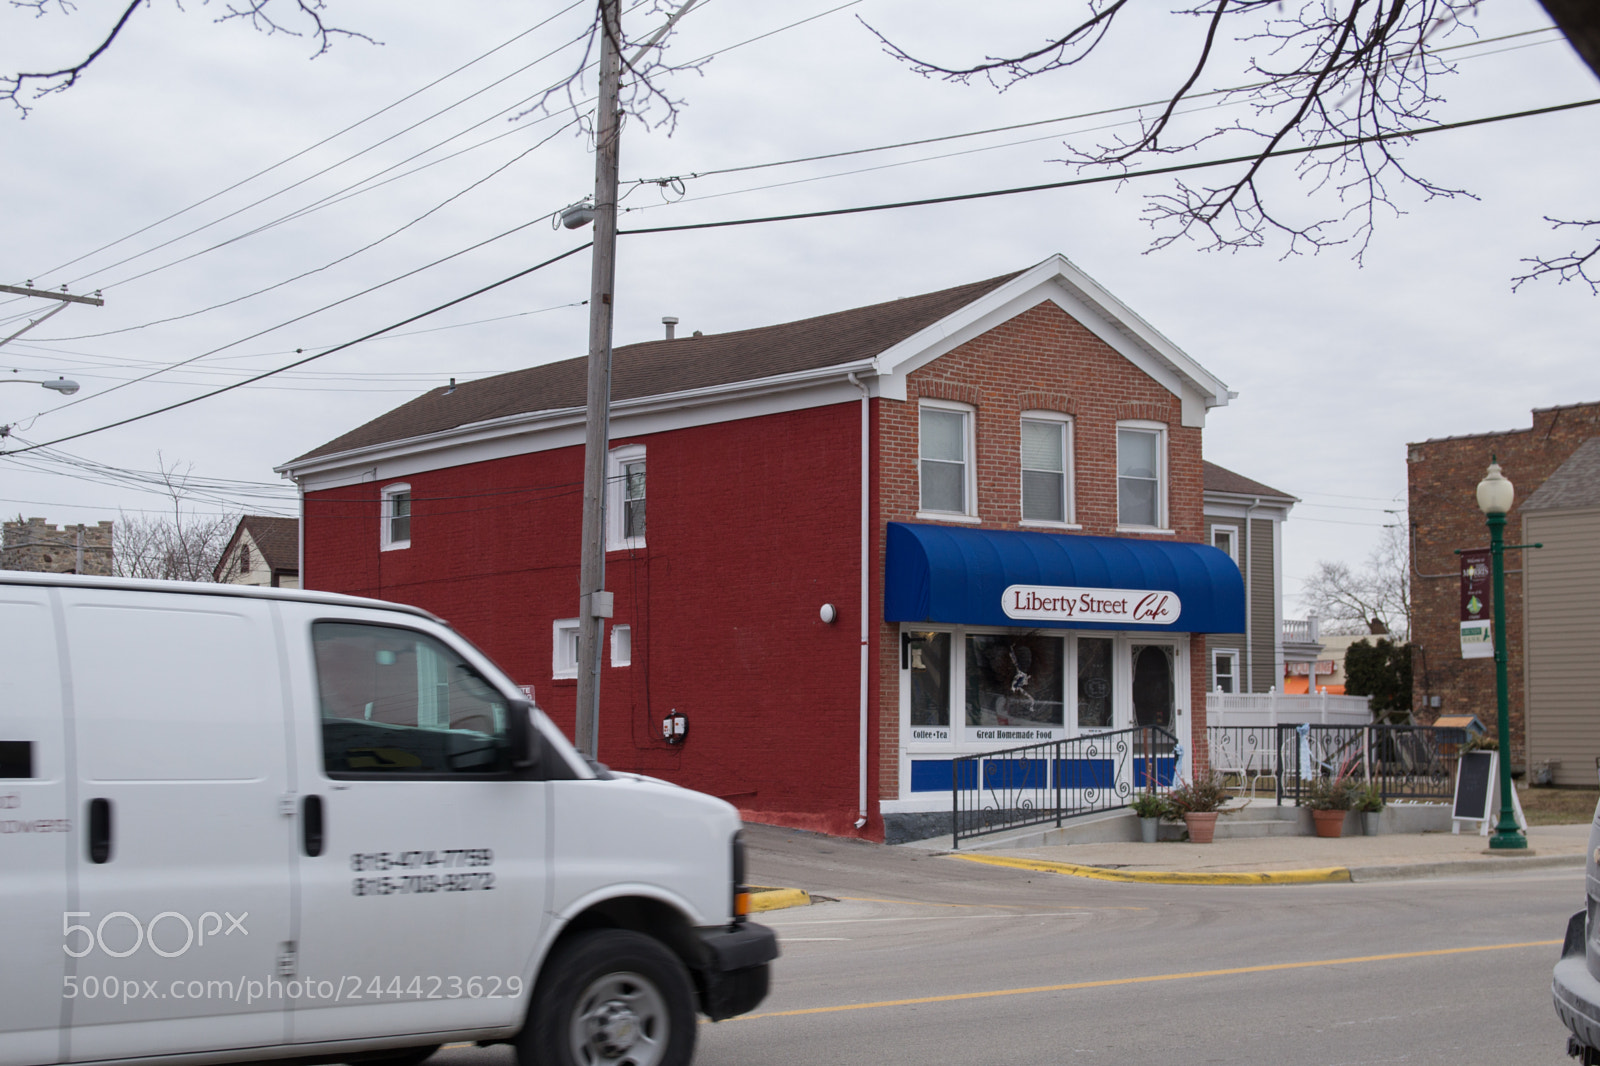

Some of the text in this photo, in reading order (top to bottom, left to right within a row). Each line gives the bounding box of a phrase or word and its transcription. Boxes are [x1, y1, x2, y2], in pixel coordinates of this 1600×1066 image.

[1014, 591, 1170, 621] Liberty Street Cafe
[976, 730, 1052, 740] Great Homemade Food
[351, 848, 494, 872] 815-474-7759
[353, 872, 496, 897] 815-703-9272
